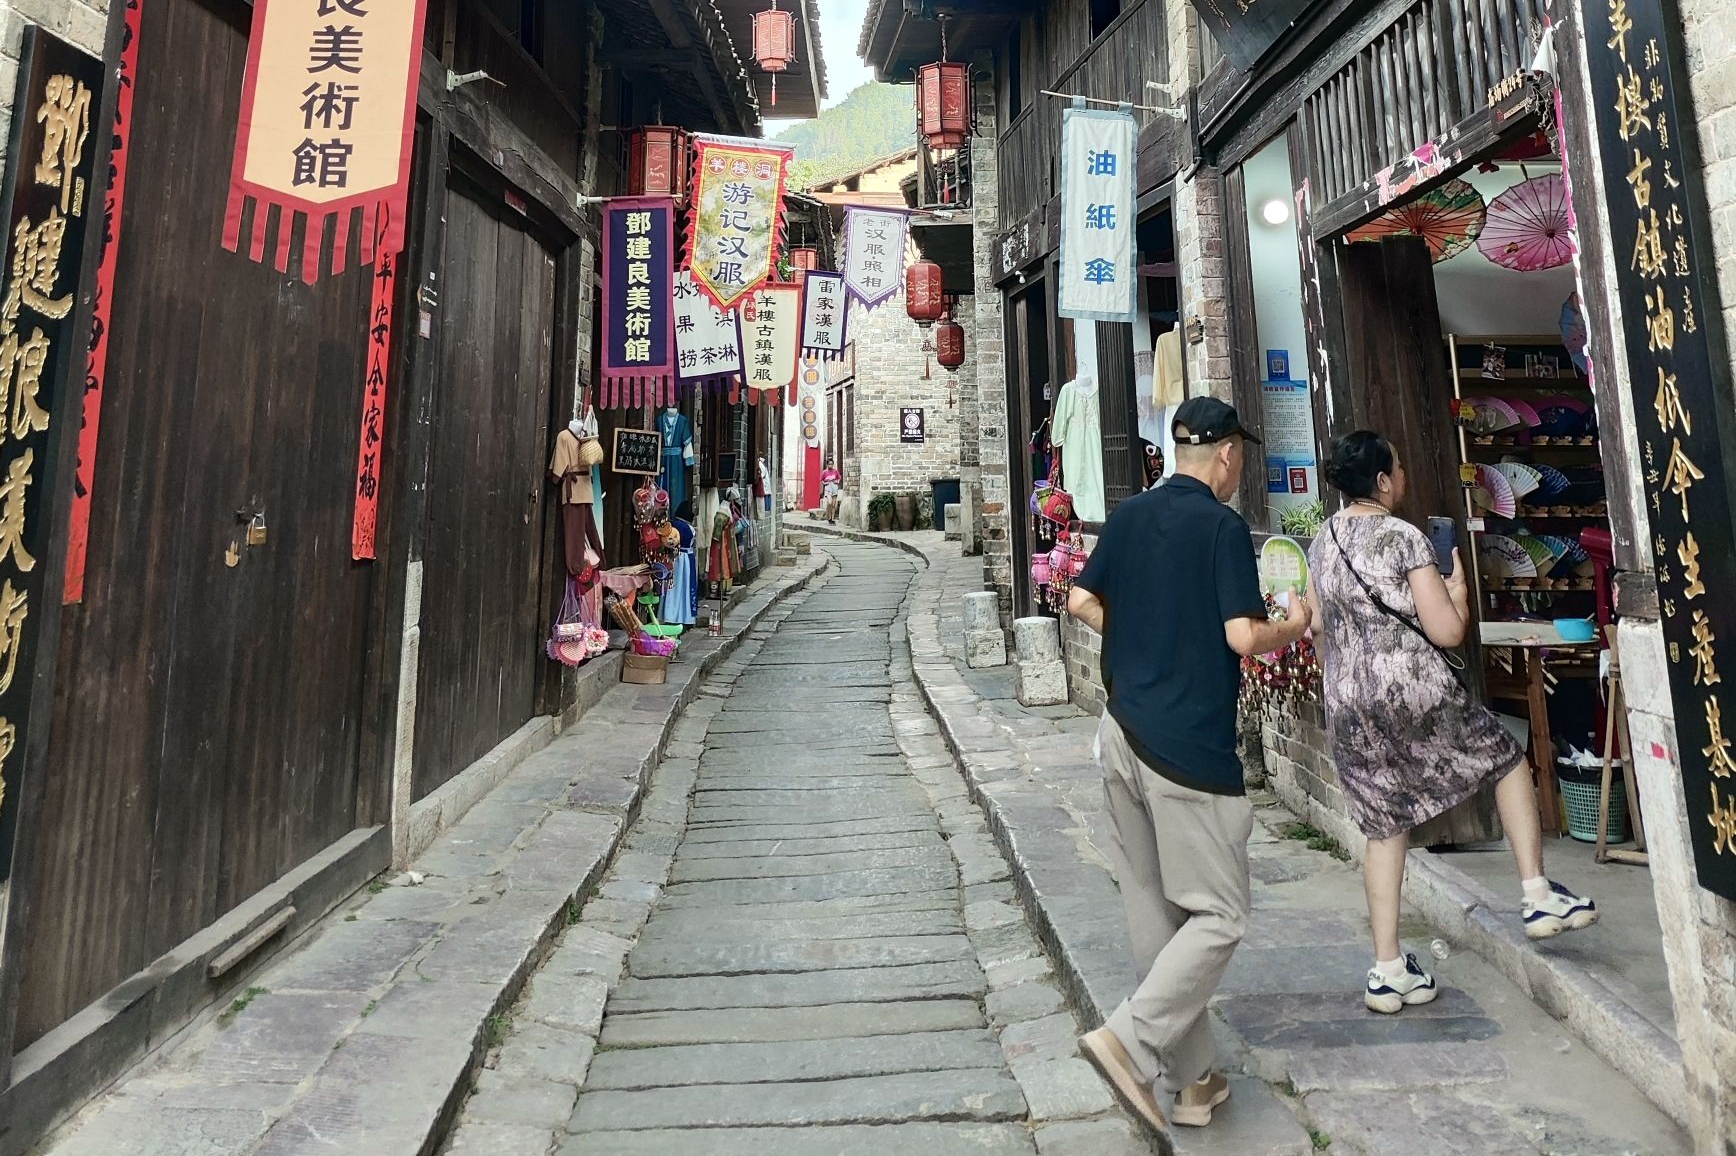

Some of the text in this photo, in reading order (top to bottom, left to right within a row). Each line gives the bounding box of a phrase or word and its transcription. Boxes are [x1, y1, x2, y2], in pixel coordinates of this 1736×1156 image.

[708, 157, 772, 178] 羊楼洞
[713, 183, 755, 284] 游记汉服
[1084, 149, 1117, 285] 油紙傘
[624, 212, 652, 362] 鄧建良美術館
[813, 280, 836, 345] 雷家漢服
[753, 296, 776, 381] 羊樓古鎮漢服
